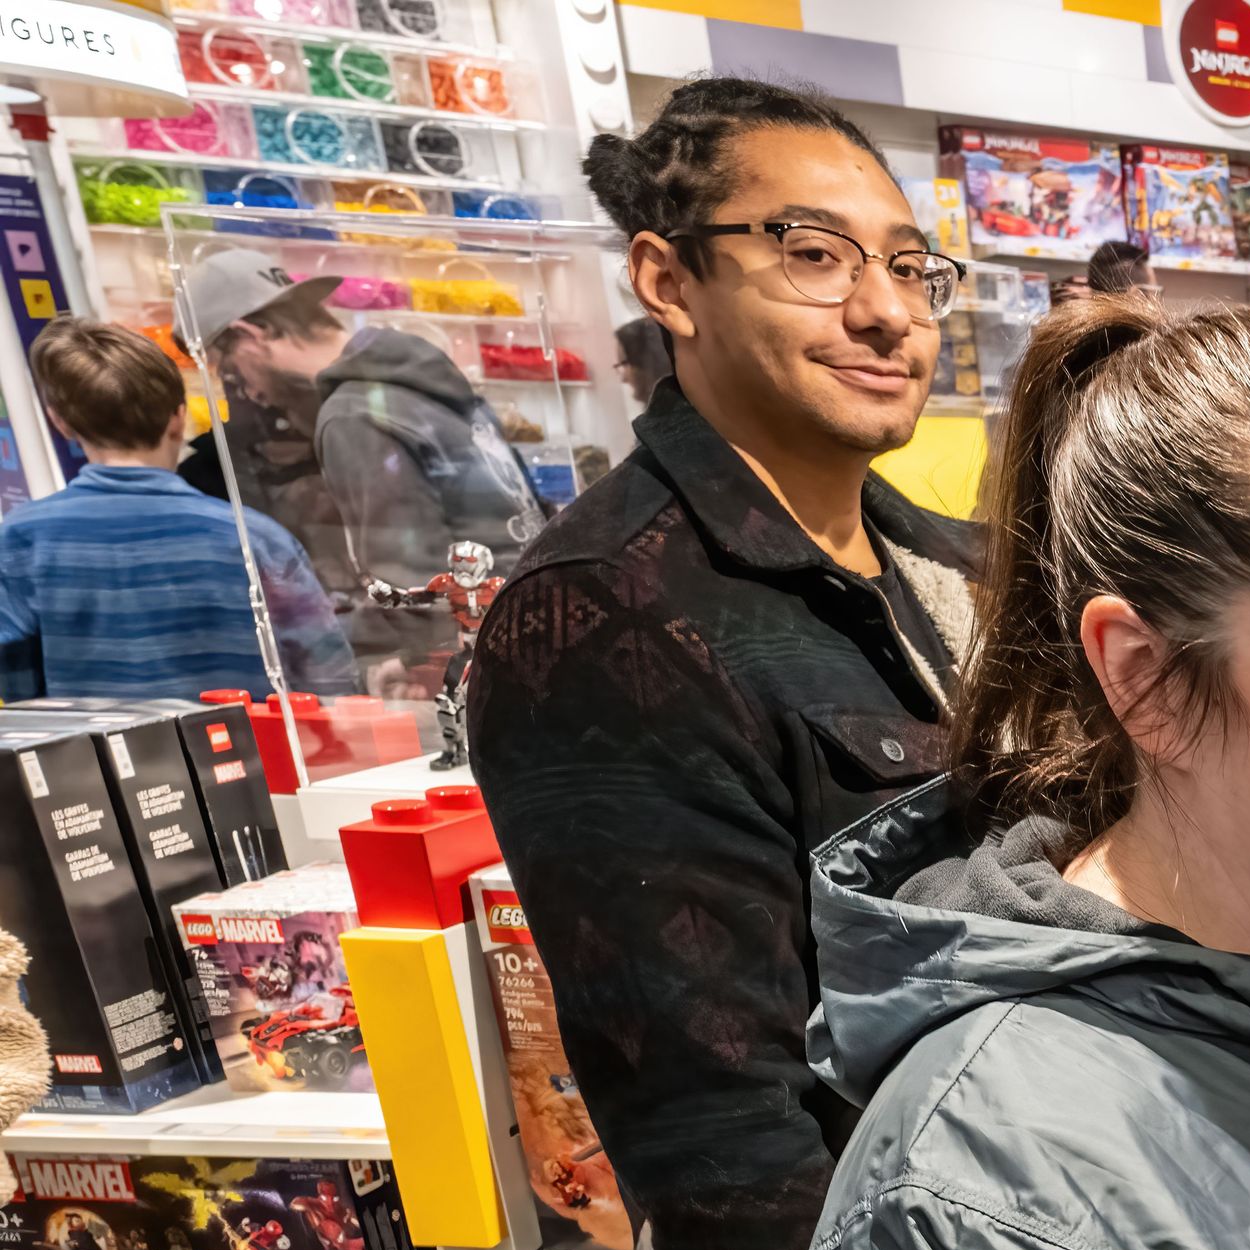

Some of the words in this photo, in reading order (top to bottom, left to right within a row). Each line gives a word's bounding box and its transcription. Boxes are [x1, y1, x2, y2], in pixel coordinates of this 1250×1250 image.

[491, 907, 529, 926] LEG
[220, 919, 284, 942] MARVEL
[494, 953, 538, 973] 10+
[30, 1163, 134, 1199] MARVEL
